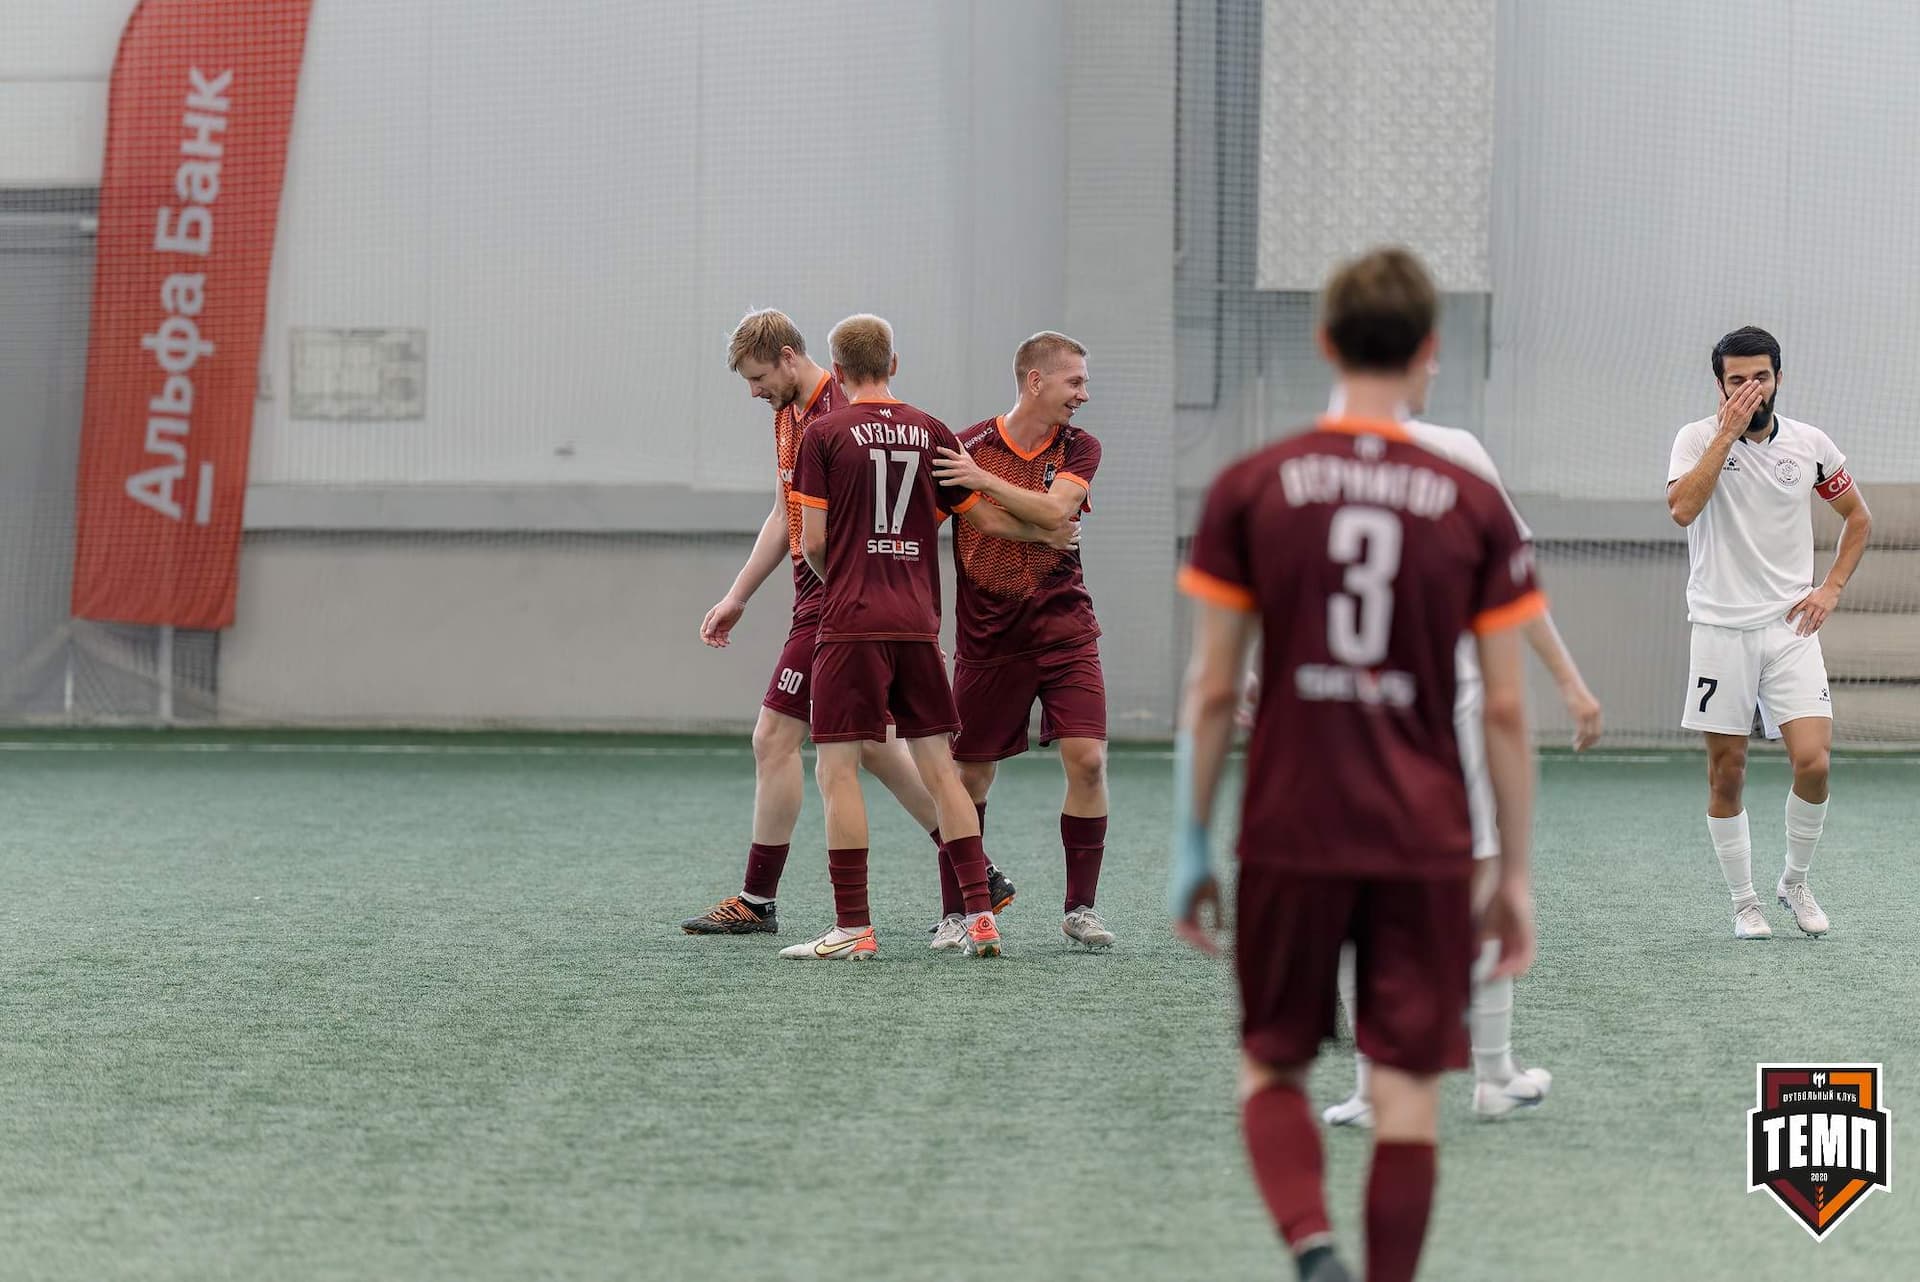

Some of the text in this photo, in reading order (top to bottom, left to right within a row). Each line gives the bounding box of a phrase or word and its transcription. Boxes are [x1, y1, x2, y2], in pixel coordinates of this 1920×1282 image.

[125, 67, 234, 520] Альфа Банк
[850, 422, 929, 450] КУЗЬКИН
[869, 448, 920, 534] 17
[866, 539, 920, 556] SEUS
[1327, 504, 1403, 666] 3
[778, 667, 804, 695] 90
[1697, 676, 1718, 713] 7
